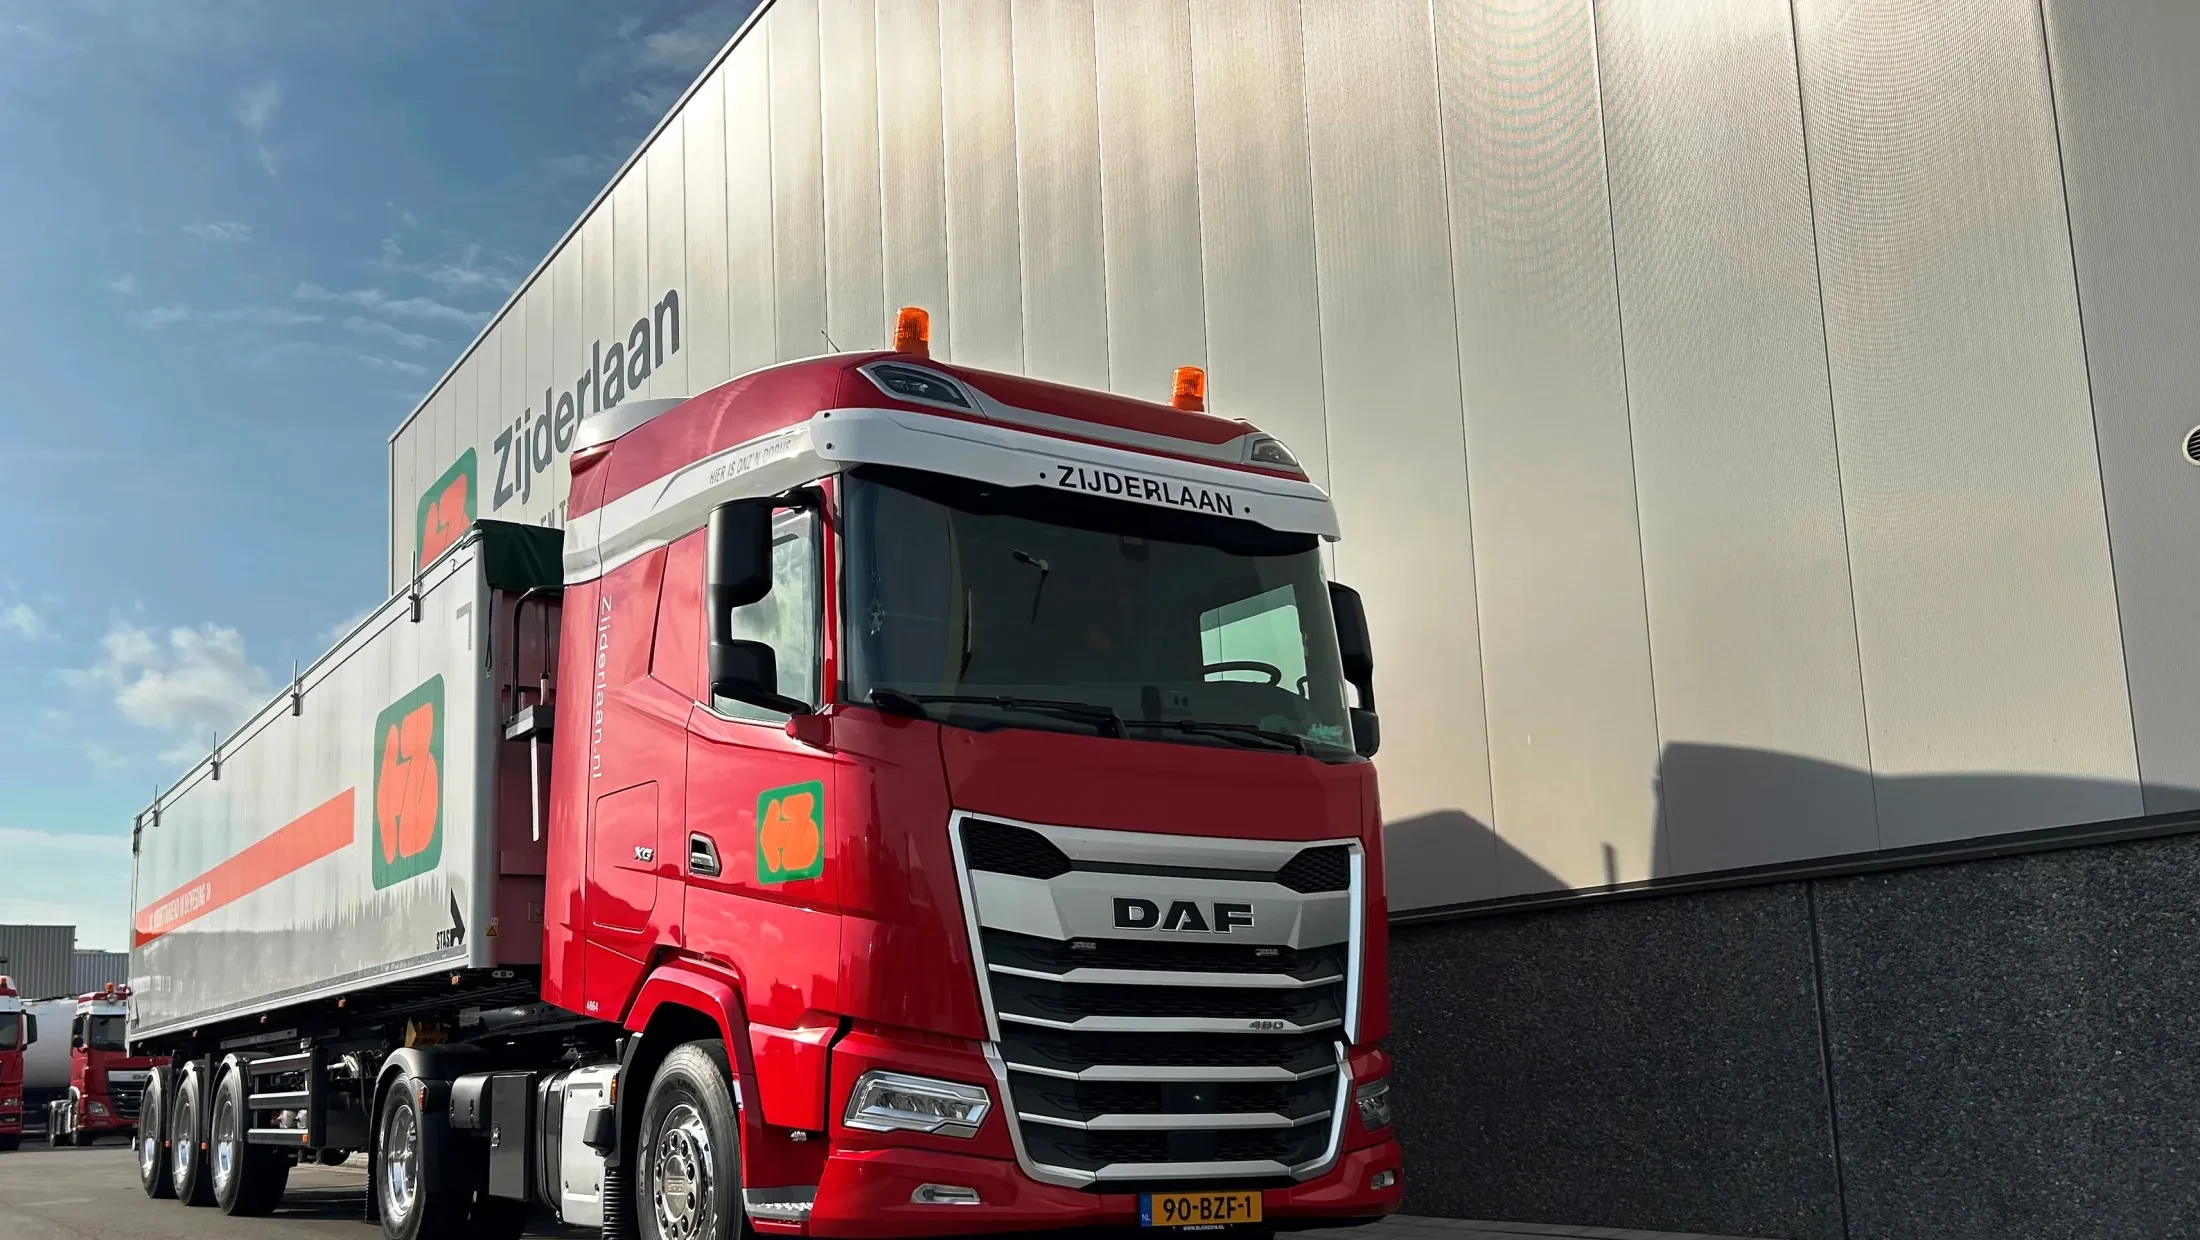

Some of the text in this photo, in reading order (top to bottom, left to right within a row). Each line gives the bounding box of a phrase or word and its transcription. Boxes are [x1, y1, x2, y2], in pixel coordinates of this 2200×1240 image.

[494, 289, 680, 513] Zijderlaan
[709, 465, 726, 486] HIER
[727, 460, 736, 477] IS
[1057, 464, 1234, 516] ZIJDERLAAN
[592, 594, 613, 779] Zijderlaan.nl
[1111, 896, 1255, 934] DAF
[436, 929, 450, 950] STAS
[1249, 1020, 1284, 1030] 480
[1141, 1213, 1151, 1221] NL
[1163, 1196, 1251, 1221] 90-BZF-1
